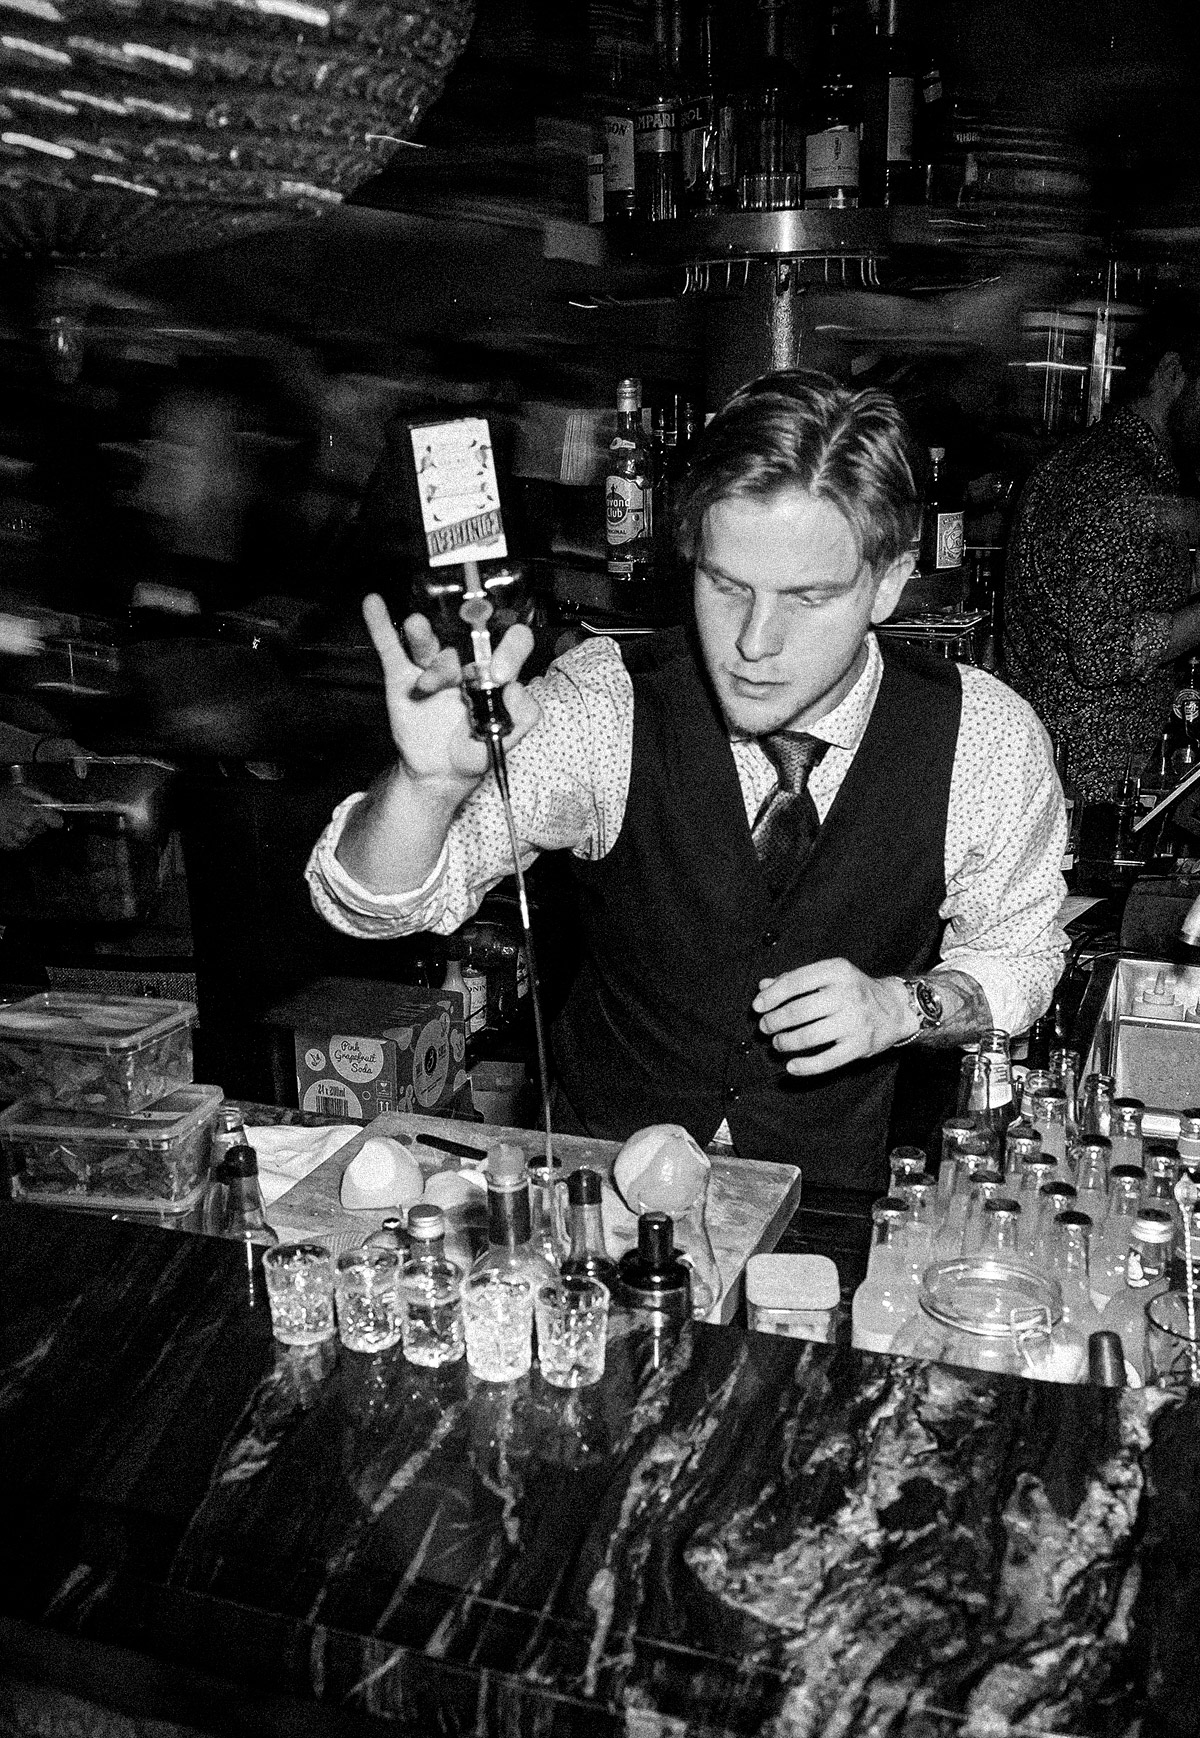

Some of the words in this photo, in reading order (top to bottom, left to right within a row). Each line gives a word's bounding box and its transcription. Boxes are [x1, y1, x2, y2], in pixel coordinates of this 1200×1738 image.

[606, 507, 623, 518] Club
[427, 511, 500, 557] COINTREAU
[340, 1040, 360, 1052] Pink
[334, 1049, 377, 1064] Grapefruit
[350, 1062, 373, 1074] Soda
